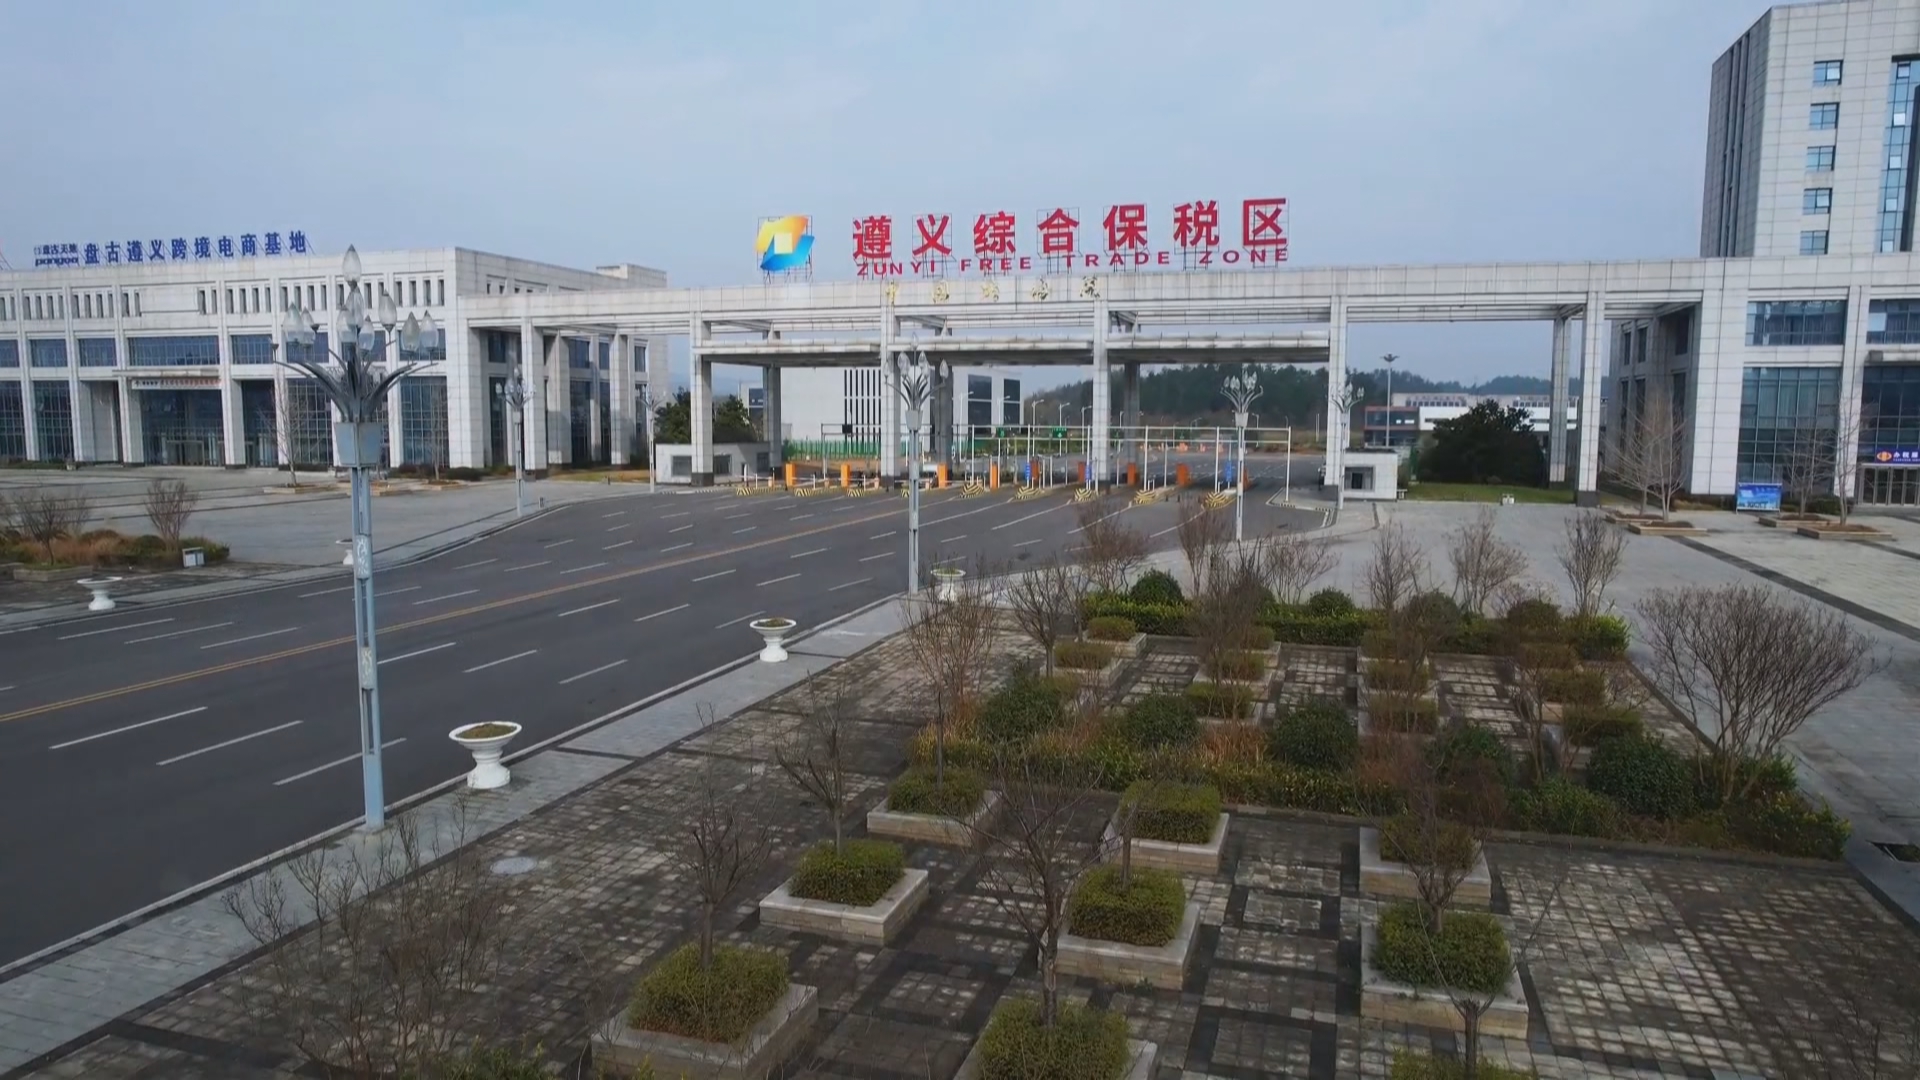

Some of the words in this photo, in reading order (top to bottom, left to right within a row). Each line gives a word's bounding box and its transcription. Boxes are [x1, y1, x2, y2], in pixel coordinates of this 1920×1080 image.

[853, 198, 1287, 259] 遵义综合保税区
[84, 230, 306, 264] 盘古遵义跨境电商基地
[857, 260, 936, 276] ZUNYI
[960, 256, 1031, 272] FREE
[1062, 250, 1169, 268] TRADE
[1199, 247, 1288, 264] ZONE
